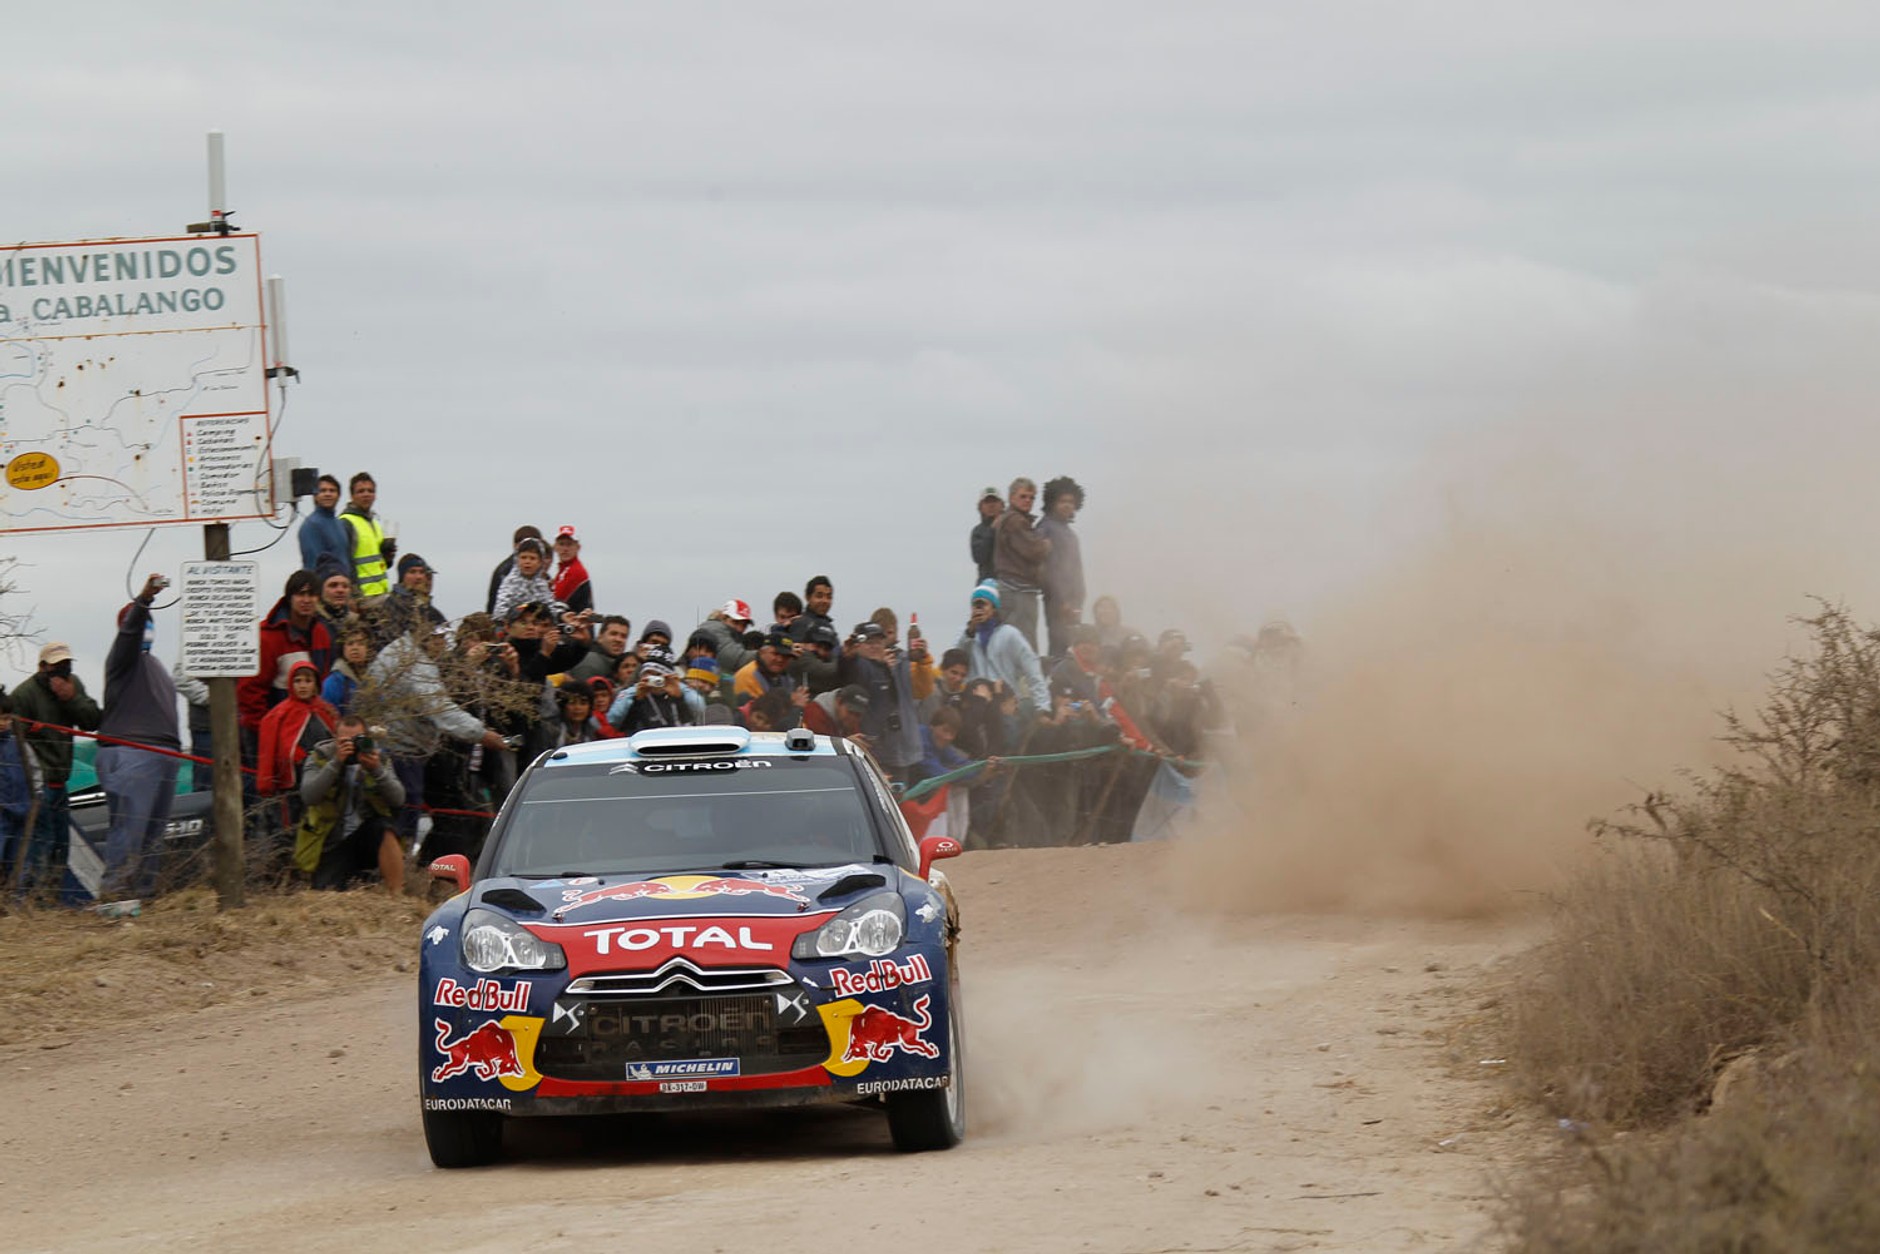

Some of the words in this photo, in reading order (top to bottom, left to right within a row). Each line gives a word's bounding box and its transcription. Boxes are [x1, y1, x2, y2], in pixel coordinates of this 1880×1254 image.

[0, 246, 237, 287] IENVENIDOS
[32, 287, 225, 320] CABALANGO
[430, 863, 456, 872] TOTAL
[583, 925, 773, 955] TOTAL
[655, 1061, 734, 1075] MICHELIN
[857, 1076, 949, 1094] EURODATACAR
[426, 1099, 512, 1111] EURODATACAR
